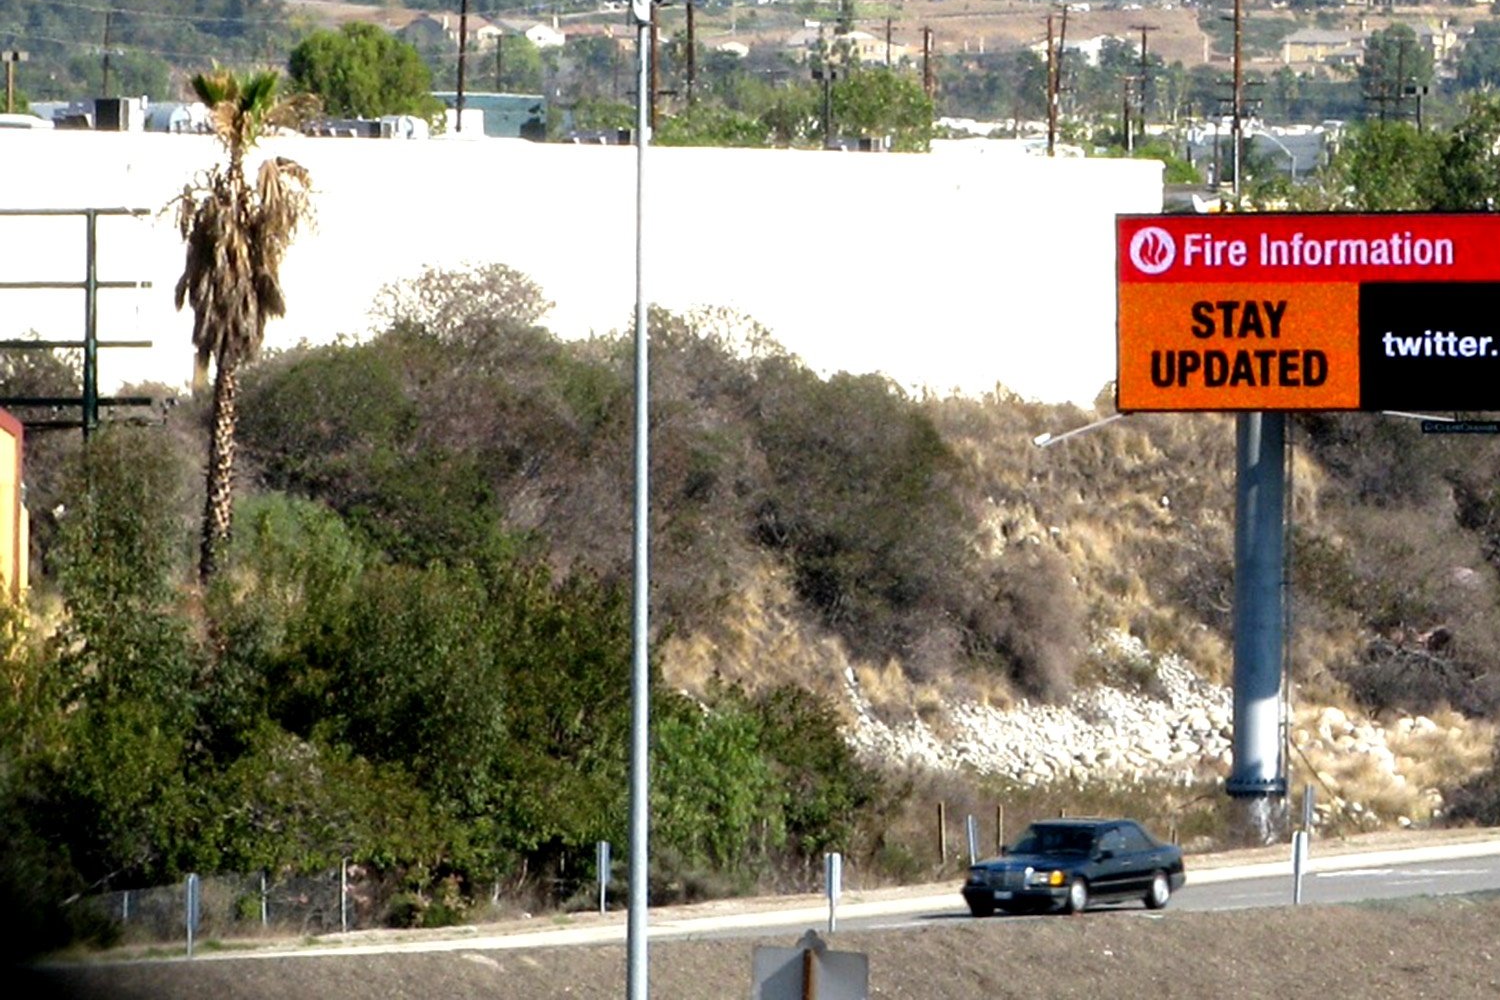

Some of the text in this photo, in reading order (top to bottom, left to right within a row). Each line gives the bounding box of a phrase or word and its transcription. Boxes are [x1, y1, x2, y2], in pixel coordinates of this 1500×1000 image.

[1183, 231, 1454, 266] Fire Information
[1190, 300, 1287, 339] STAY
[1150, 349, 1328, 388] UPDATED
